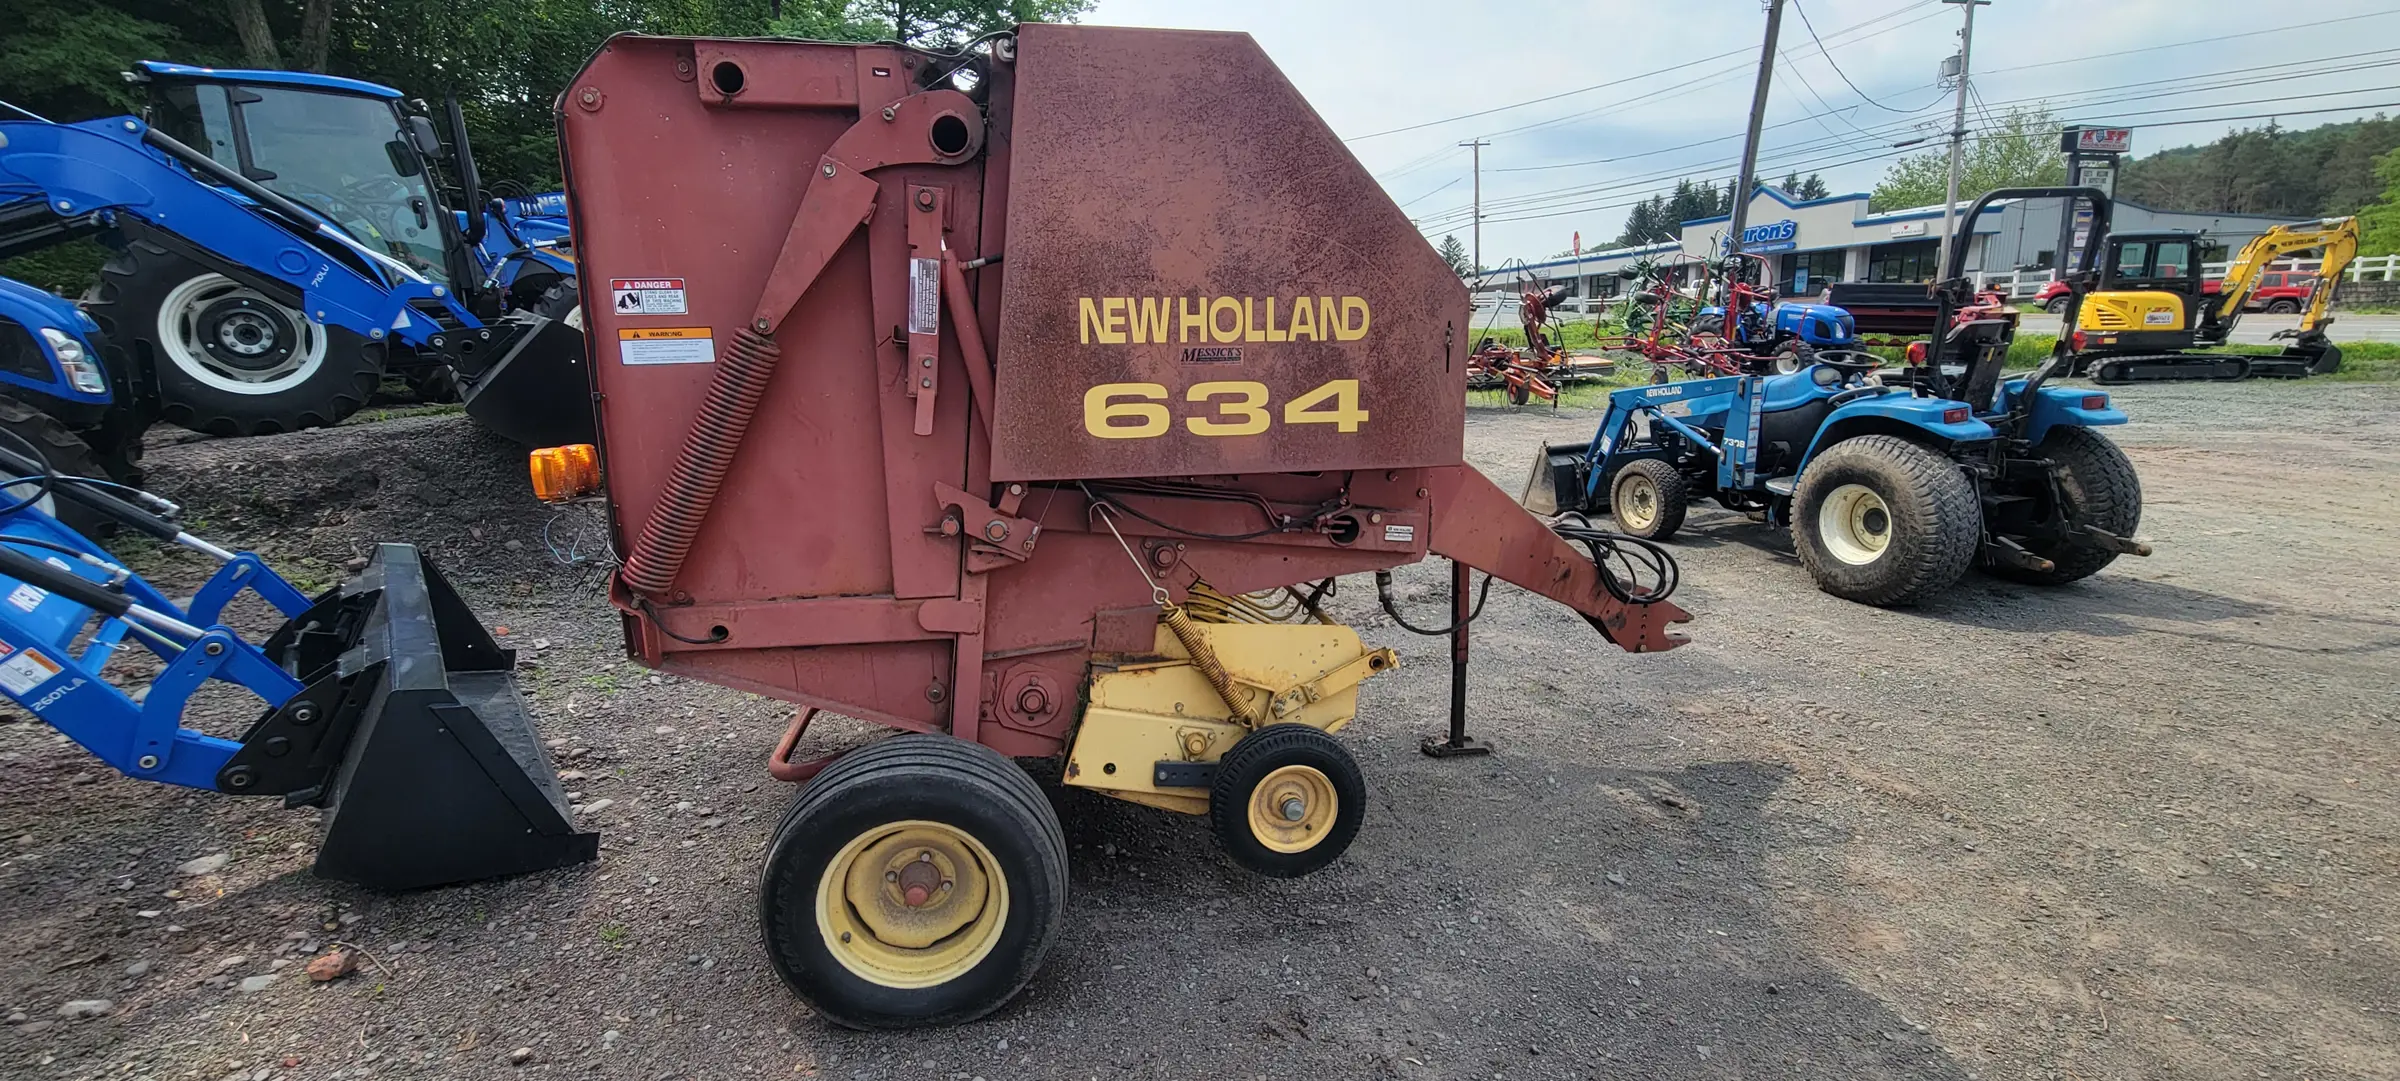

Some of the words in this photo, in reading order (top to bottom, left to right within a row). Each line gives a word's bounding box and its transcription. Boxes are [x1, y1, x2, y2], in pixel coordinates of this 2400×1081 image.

[311, 263, 330, 288] 710LU
[634, 281, 671, 289] DANGER
[1078, 296, 1171, 344] NEW
[1179, 296, 1371, 343] HOLLAND
[1181, 347, 1242, 362] MESSICK'S
[1646, 389, 1659, 397] NEW
[1658, 386, 1682, 396] HOLLAND
[1083, 379, 1370, 439] 634
[30, 677, 87, 712] 260TLA
